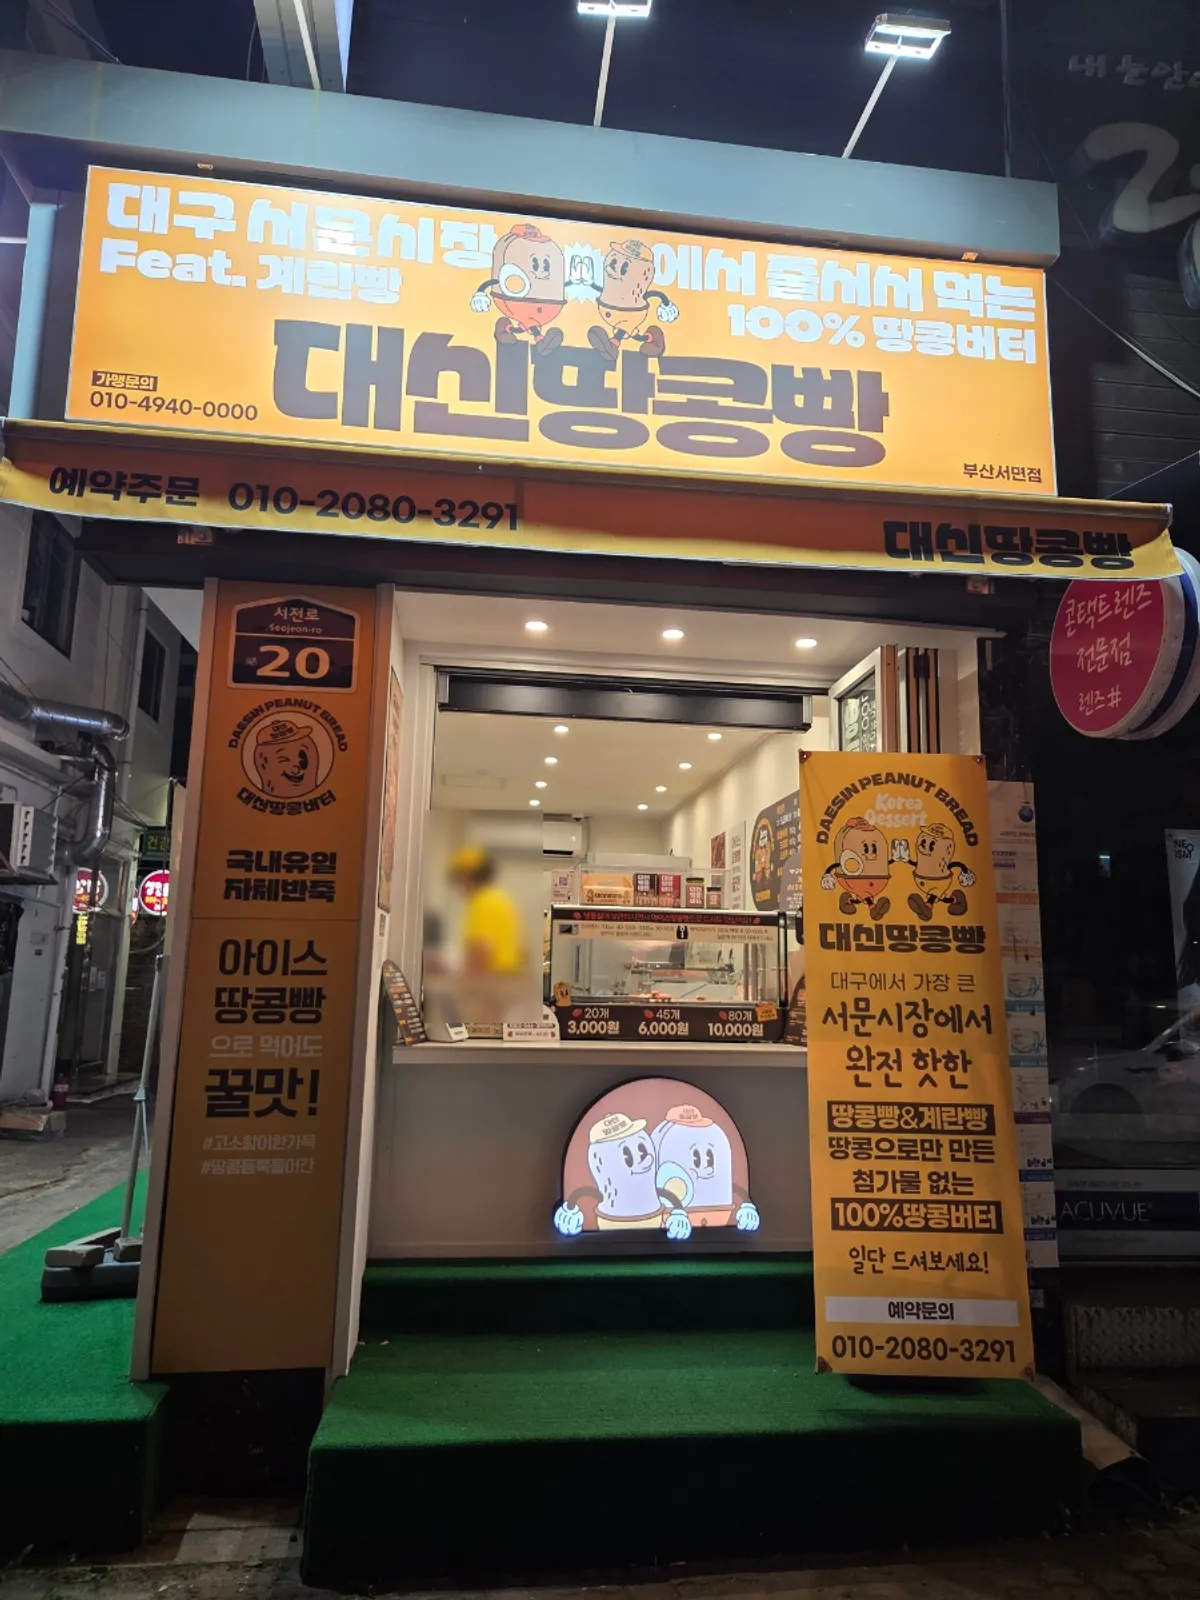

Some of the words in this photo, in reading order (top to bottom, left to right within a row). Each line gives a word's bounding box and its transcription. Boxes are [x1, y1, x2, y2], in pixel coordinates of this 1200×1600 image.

[107, 182, 236, 240] 대구
[247, 199, 498, 270] 서문시장
[652, 243, 756, 297] 에서
[766, 254, 924, 312] 줄서서
[933, 271, 1036, 323] 먹는
[100, 238, 246, 289] Feat.
[256, 255, 402, 305] 계란빵
[727, 304, 866, 349] 100%
[873, 314, 1037, 364] 땅콩버터
[96, 371, 156, 391] 가맹문의
[272, 318, 890, 468] 대신땅콩빵
[89, 391, 258, 422] 010-4940-0000
[962, 462, 1043, 484] 부산서면점
[49, 466, 201, 507] 예약주문
[228, 482, 519, 531] 010-2080-3291
[883, 520, 1134, 571] 대신땅콩빵
[273, 606, 320, 623] 서전로
[269, 623, 322, 635] Seojeon-ro
[256, 645, 330, 679] 20
[1077, 632, 1133, 673] 전문점
[228, 705, 267, 749] DAESIN
[264, 698, 322, 713] PEANUT
[319, 709, 347, 752] BREAD
[816, 784, 861, 846] DAESIN
[857, 772, 936, 794] PEANUT
[933, 787, 979, 847] BREAD
[874, 793, 924, 811] Korea
[864, 809, 928, 828] Dessert
[226, 850, 337, 875] 국내유일
[223, 878, 336, 902] 자체반죽
[819, 923, 986, 955] 대신땅콩빵
[218, 939, 328, 976] 아이스
[830, 972, 906, 991] 대구에서
[913, 973, 950, 992] 가장
[956, 974, 976, 992] 큰
[214, 986, 326, 1024] 땅콩빵
[585, 1007, 609, 1019] 20개
[656, 1008, 680, 1021] 45개
[728, 1010, 752, 1022] 80개
[821, 997, 992, 1038] 서문시장에서
[567, 1020, 620, 1035] 3,000원
[638, 1021, 689, 1036] 6,000원
[708, 1022, 764, 1037] 10,000원
[209, 1034, 254, 1059] 으로
[258, 1034, 323, 1059] 먹어도
[845, 1044, 902, 1088] 완전
[911, 1047, 973, 1090] 핫한
[204, 1068, 320, 1119] 꿀맛!
[831, 1103, 988, 1131] 땅콩빵&계란빵
[828, 1136, 943, 1162] 땅콩으로만
[948, 1138, 995, 1164] 만든
[852, 1169, 922, 1195] 첨가물
[927, 1171, 975, 1196] 없는
[835, 1201, 998, 1230] 100%땅콩버터
[1060, 1200, 1150, 1222] ACUVUE
[849, 1245, 886, 1275] 일단
[891, 1250, 989, 1274] 드셔보세요!
[887, 1301, 955, 1321] 예약문의
[831, 1334, 1016, 1363] 010-2080-3291
